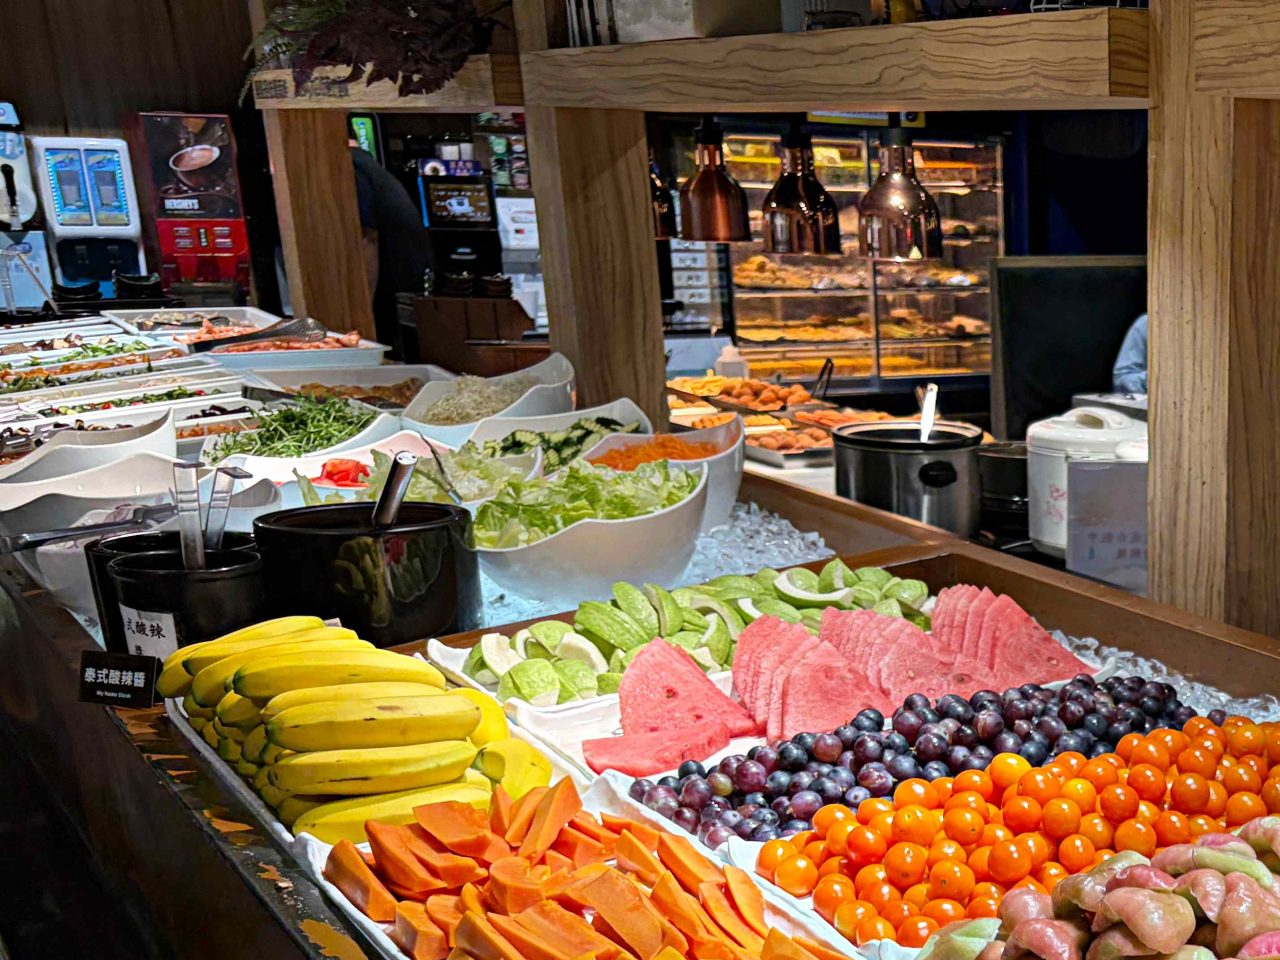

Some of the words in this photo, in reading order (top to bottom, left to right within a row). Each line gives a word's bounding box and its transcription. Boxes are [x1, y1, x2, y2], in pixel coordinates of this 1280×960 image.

[84, 667, 145, 687] 泰式酸辣醬
